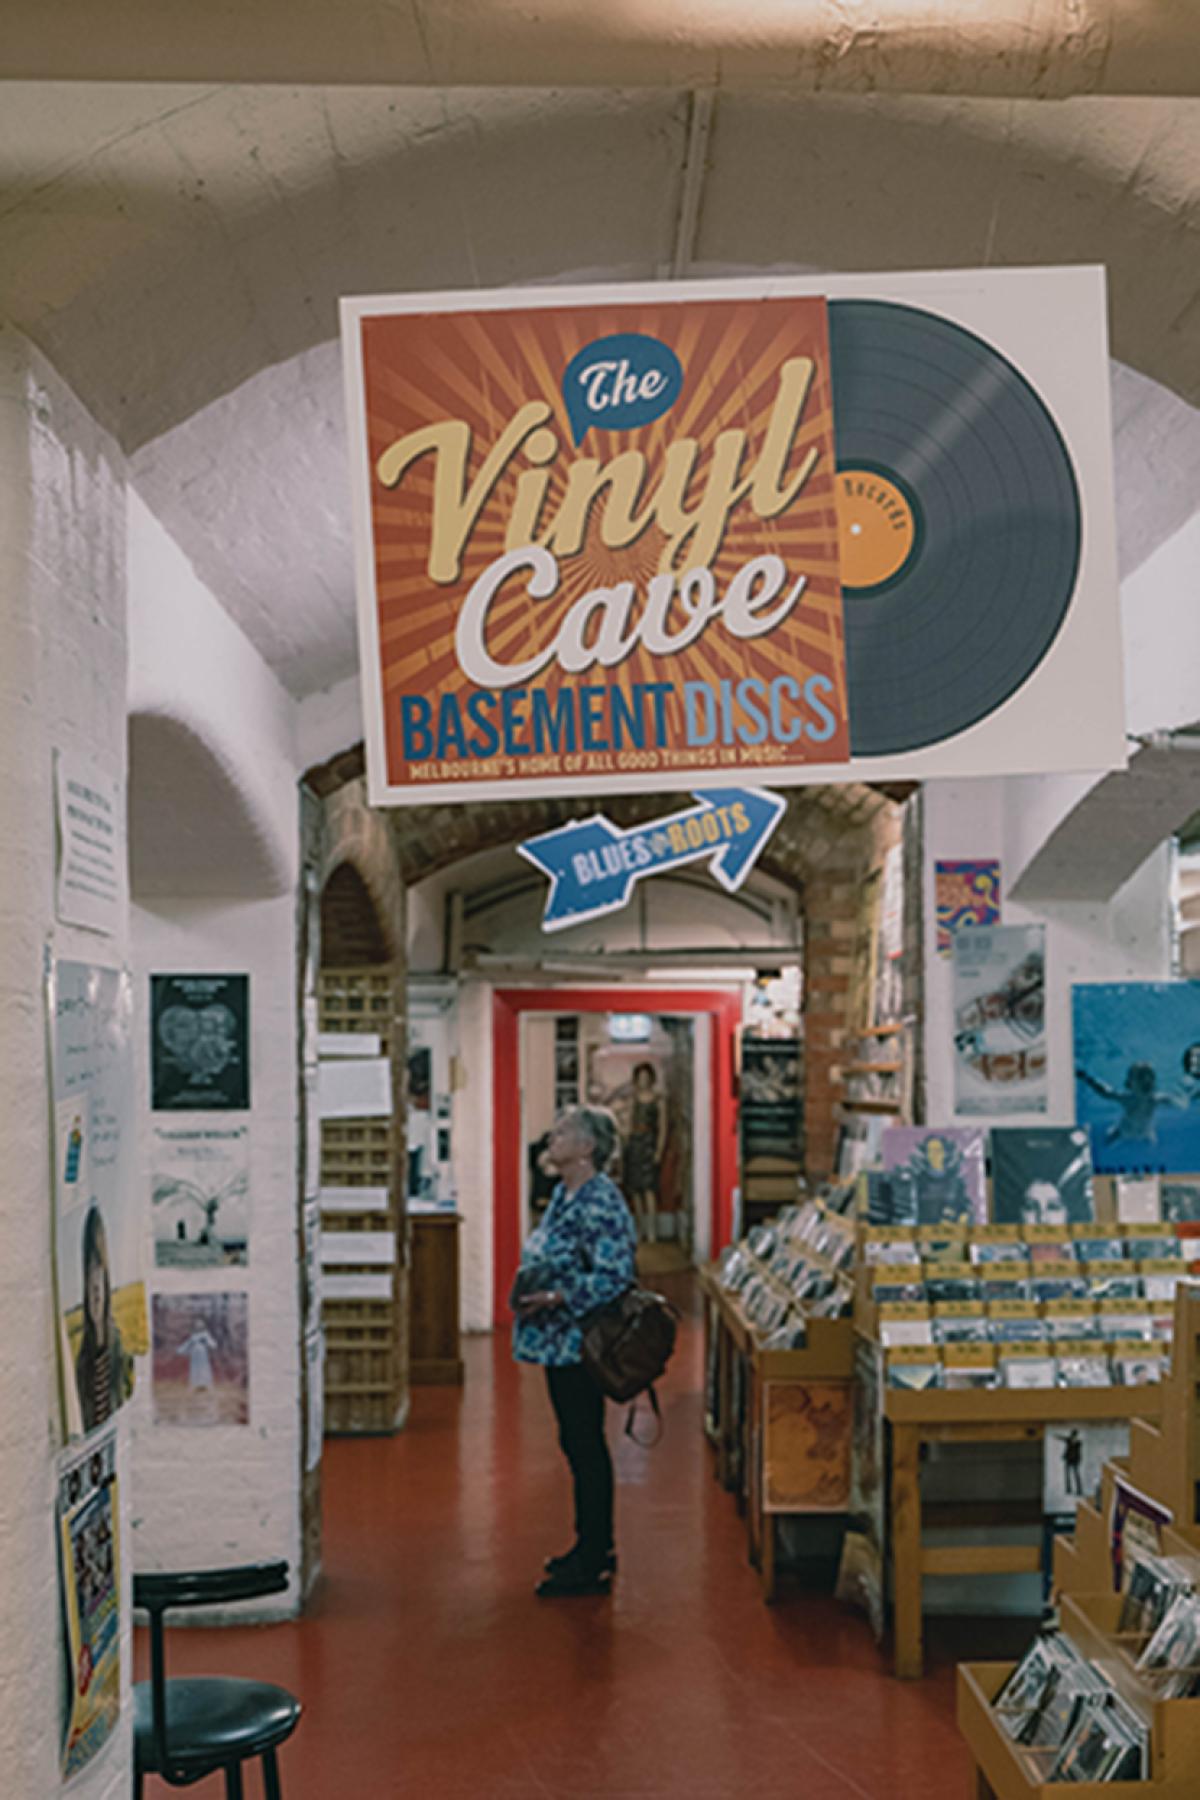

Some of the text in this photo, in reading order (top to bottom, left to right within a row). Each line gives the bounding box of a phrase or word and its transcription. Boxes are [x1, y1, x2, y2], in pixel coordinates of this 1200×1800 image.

[579, 360, 668, 410] The
[377, 357, 818, 584] Vinyl
[456, 546, 806, 688] Cave
[400, 674, 836, 760] BASEMENT DISCS
[409, 758, 516, 779] MELBOURNE'S
[520, 754, 561, 772] HOME
[564, 754, 582, 771] OF
[587, 752, 614, 770] ALL
[618, 750, 659, 769] GOOD
[662, 748, 716, 767] THINGS
[720, 747, 737, 764] IN
[572, 836, 651, 886] BLUES
[667, 802, 751, 853] ROOTS
